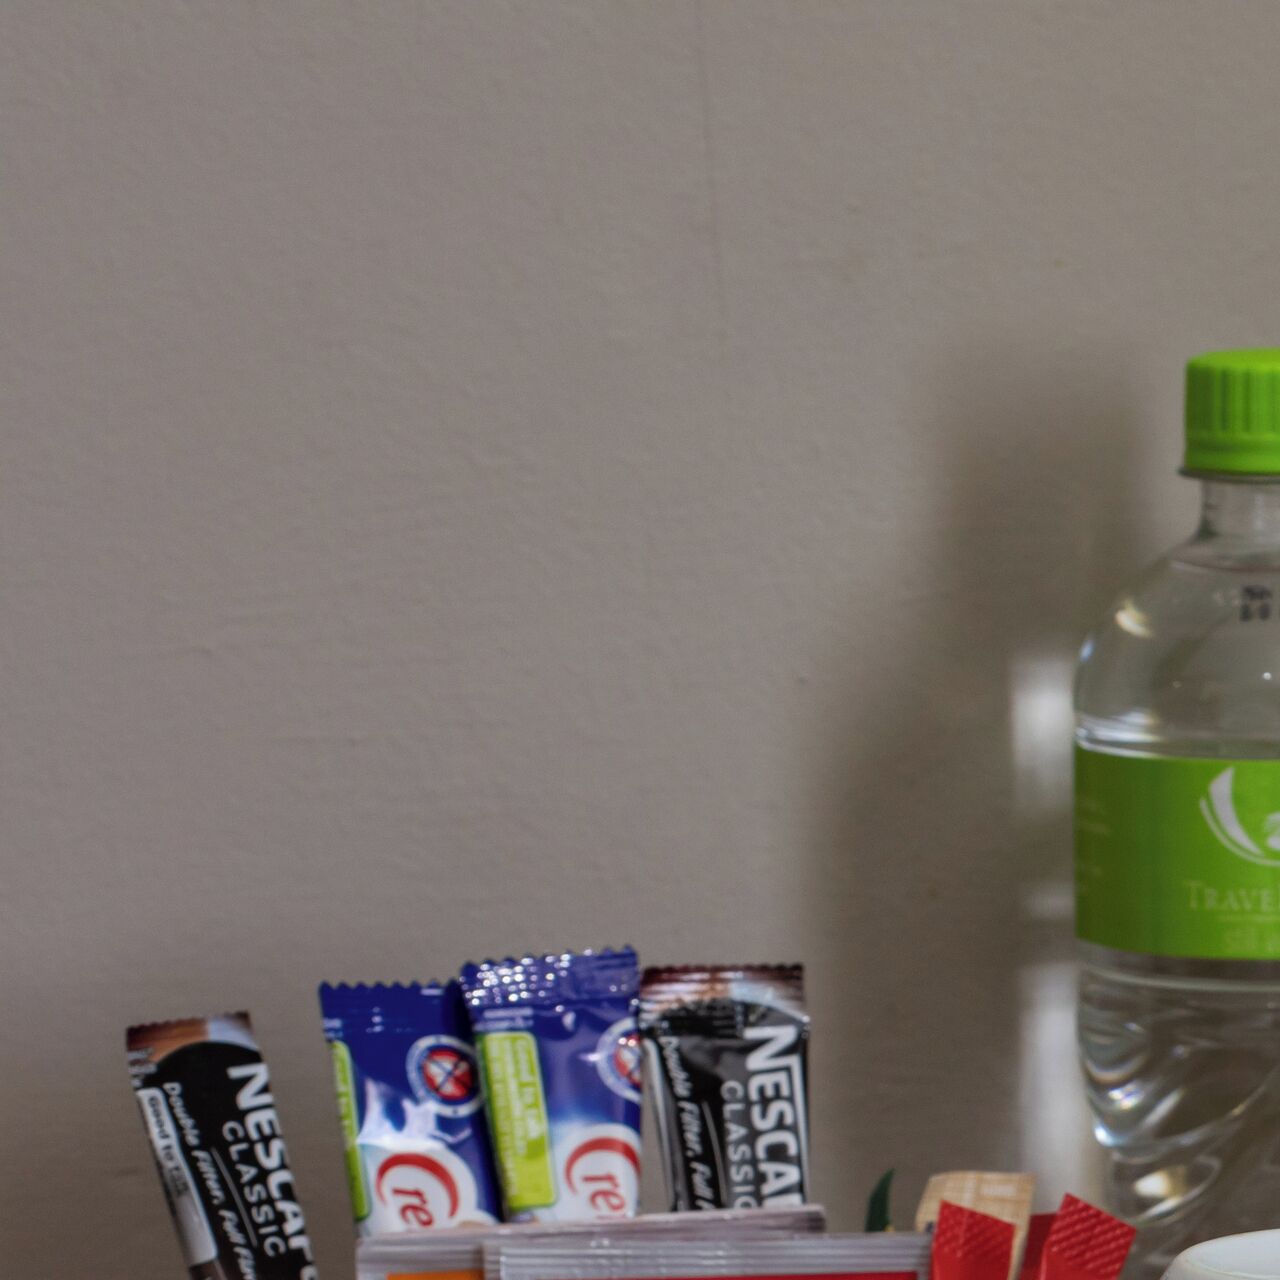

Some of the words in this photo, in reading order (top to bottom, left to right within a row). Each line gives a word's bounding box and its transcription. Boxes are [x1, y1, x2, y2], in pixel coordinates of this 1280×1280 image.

[659, 1035, 692, 1097] Double
[163, 1081, 199, 1146] Double
[218, 1209, 248, 1244] Full
[222, 1121, 287, 1257] CLASSIC
[720, 1080, 758, 1209] CLASSIC
